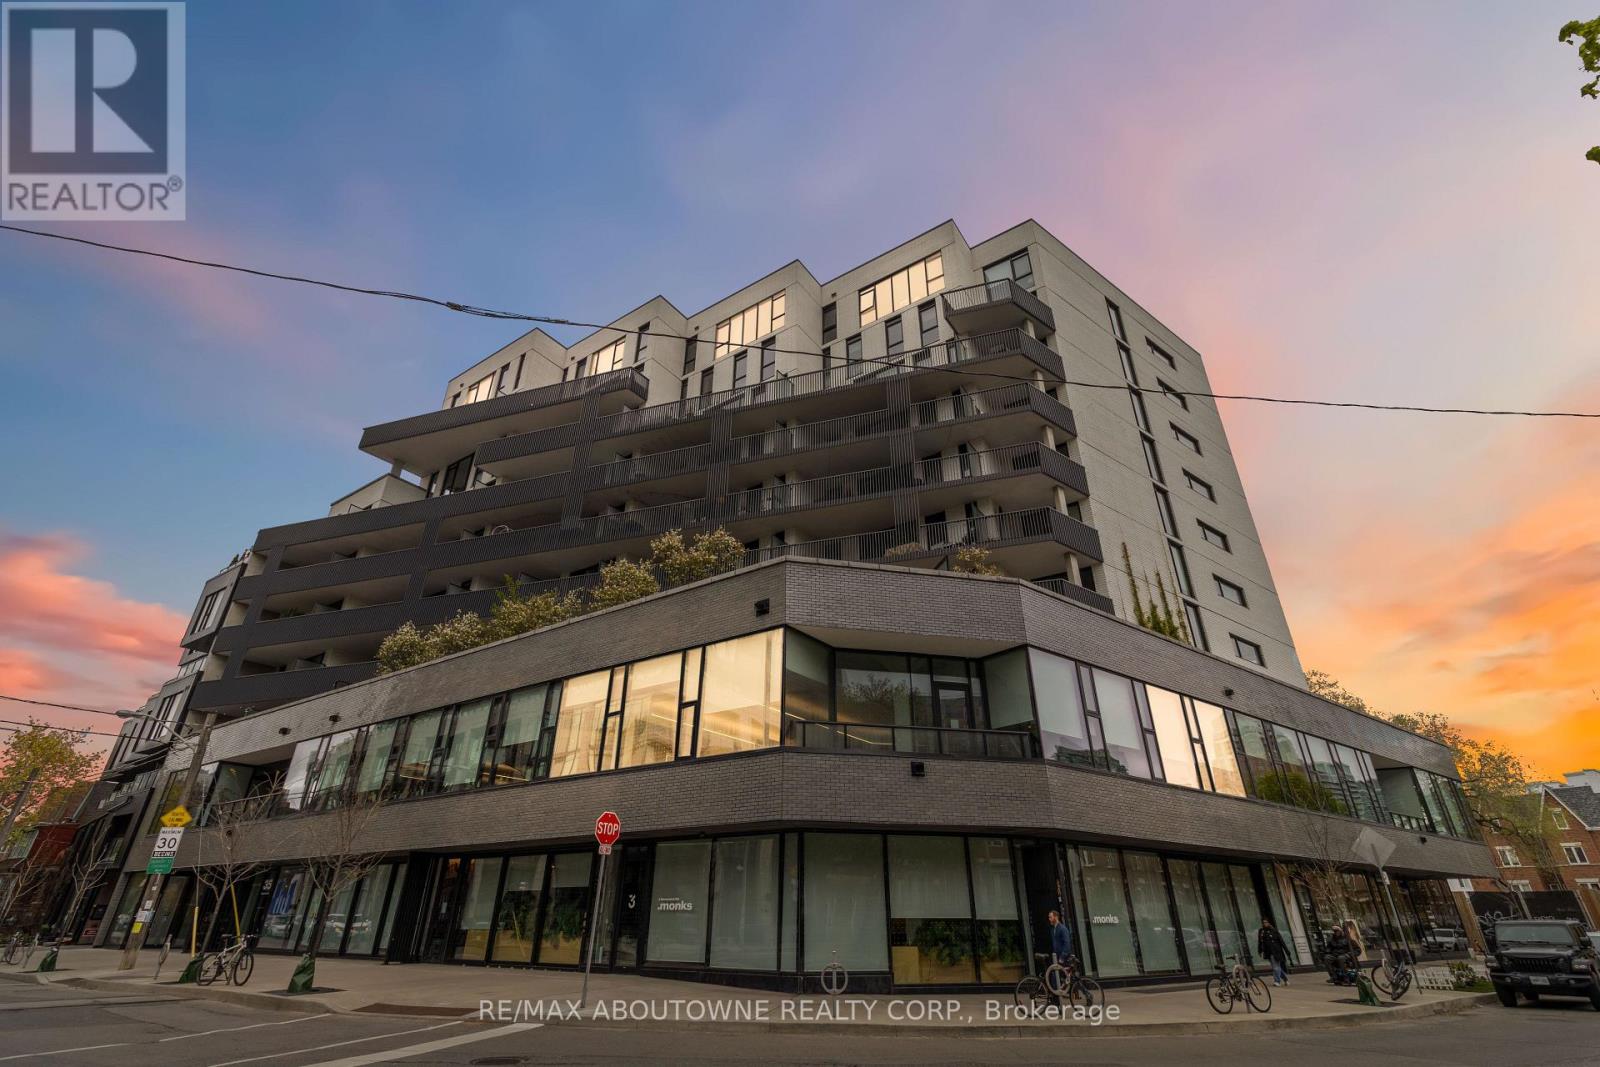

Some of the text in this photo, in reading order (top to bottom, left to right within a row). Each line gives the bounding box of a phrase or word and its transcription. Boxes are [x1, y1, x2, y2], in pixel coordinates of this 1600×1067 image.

[597, 822, 619, 835] STOP
[157, 837, 177, 849] 30
[657, 901, 693, 911] .monks
